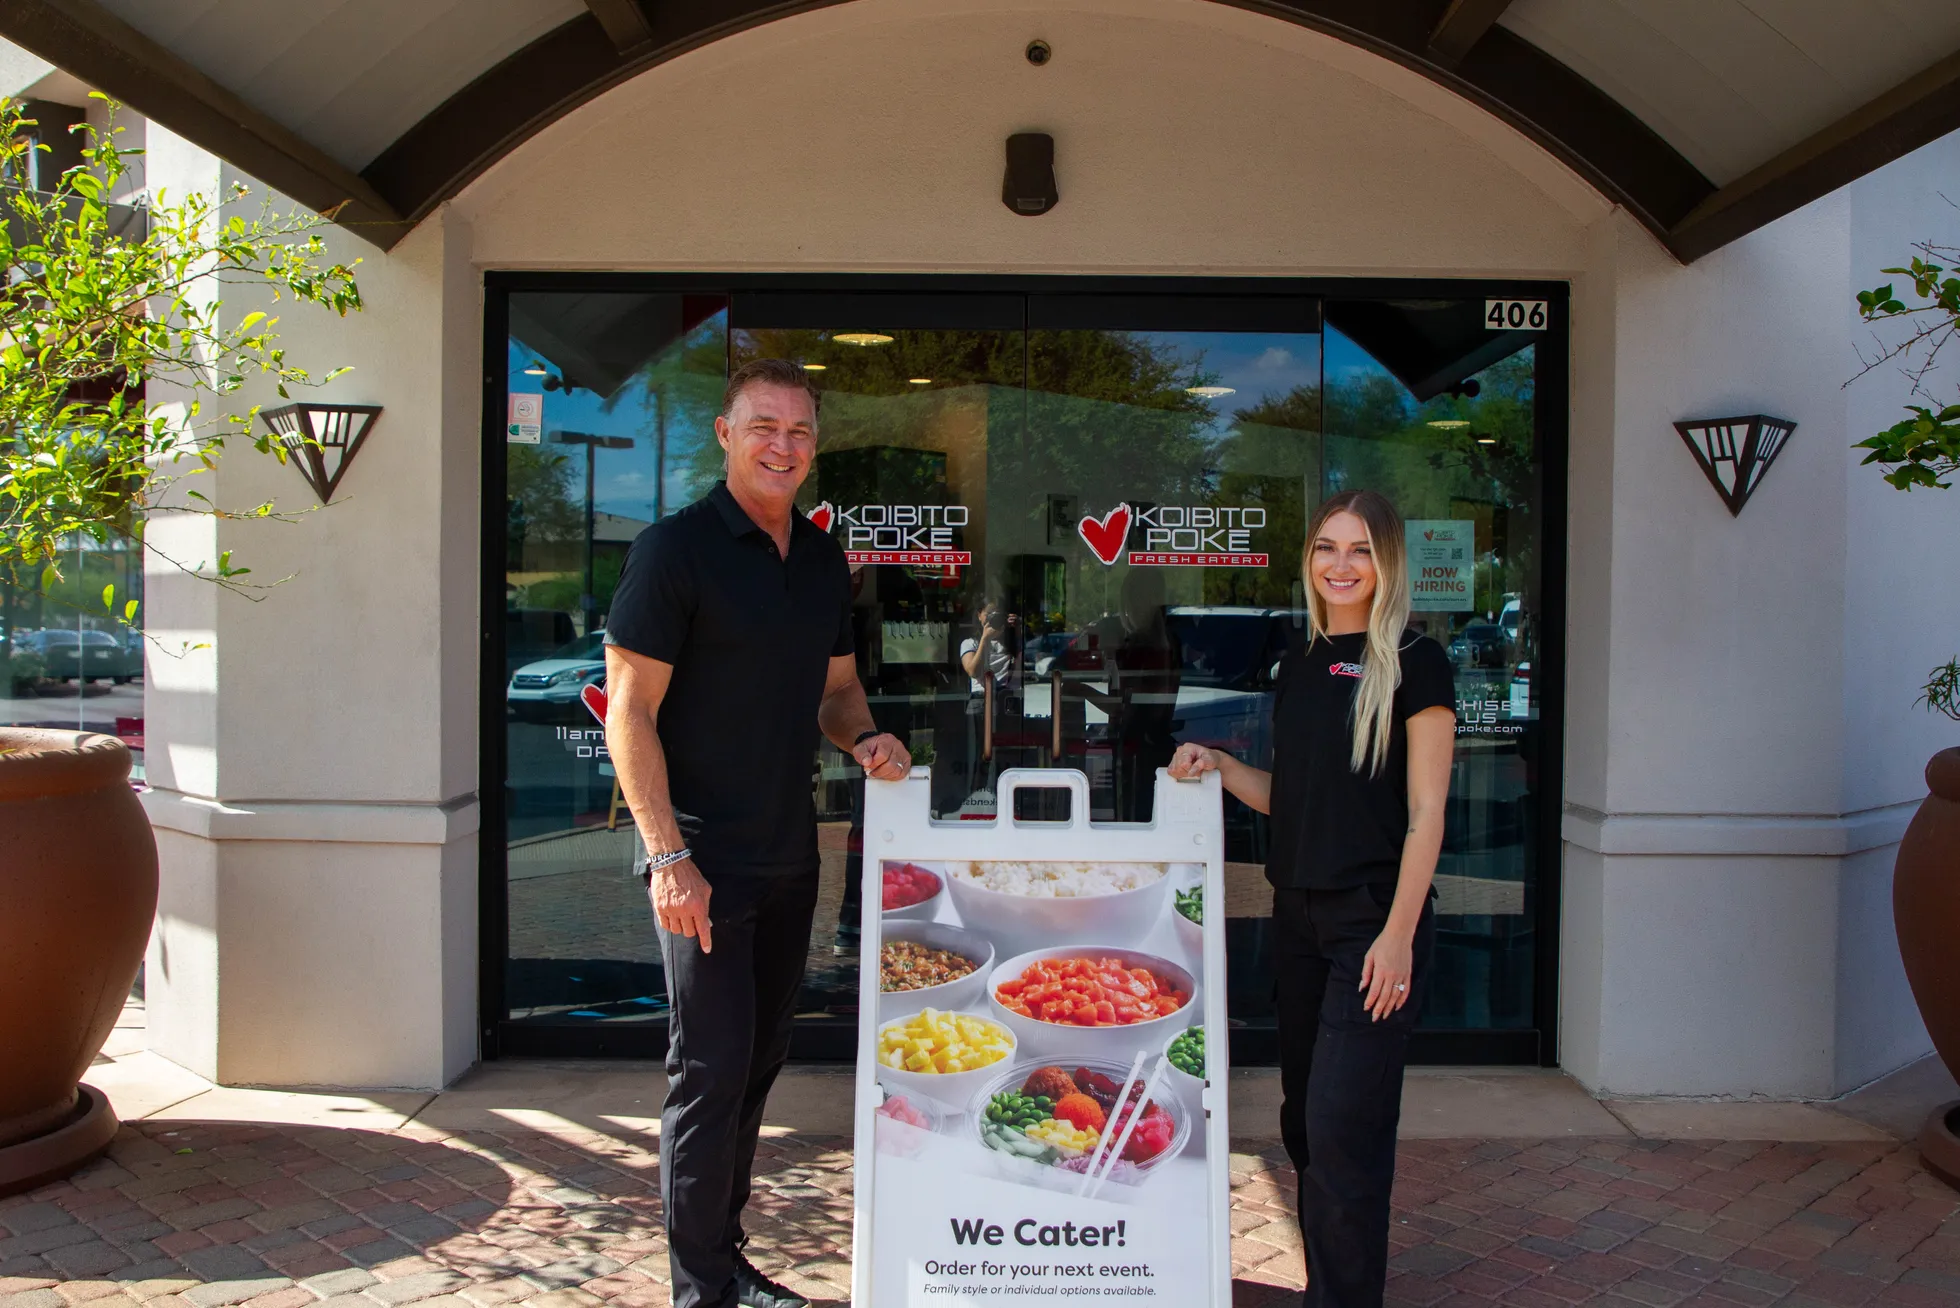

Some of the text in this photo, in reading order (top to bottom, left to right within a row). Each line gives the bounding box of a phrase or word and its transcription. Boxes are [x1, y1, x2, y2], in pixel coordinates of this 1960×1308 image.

[1488, 302, 1545, 328] 406
[838, 505, 968, 526] KOIBITO
[1136, 507, 1266, 527] KOIBITO
[848, 554, 965, 562] RESH EATERY
[1135, 555, 1262, 564] FRESH EATERY
[1422, 567, 1458, 578] NOW
[1414, 581, 1465, 592] HIRING
[1465, 713, 1496, 723] US
[950, 1218, 1126, 1247] We Cater!
[925, 1260, 1154, 1280] Order for your next event.
[923, 1284, 1157, 1297] Family style or individual options available.
